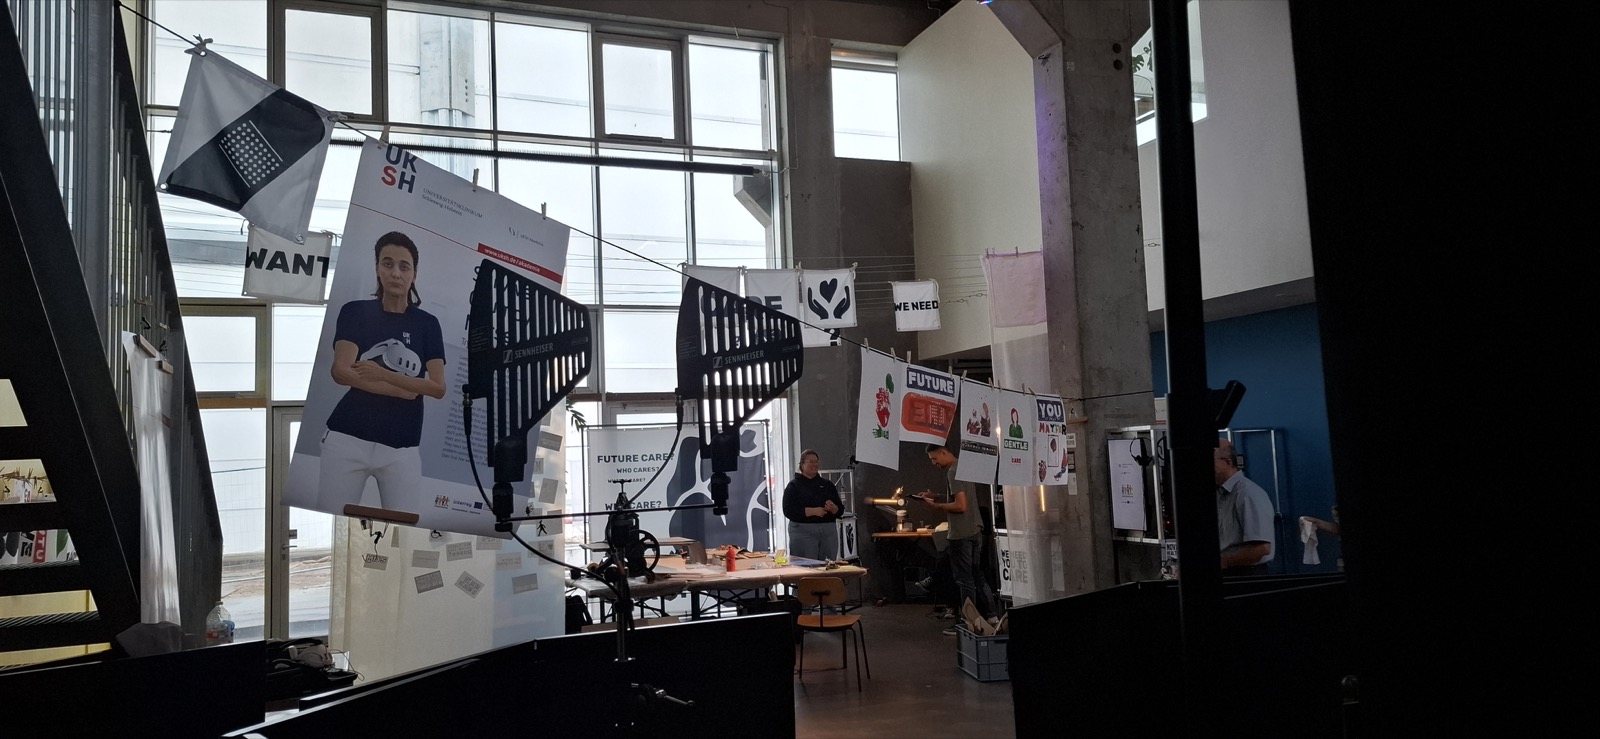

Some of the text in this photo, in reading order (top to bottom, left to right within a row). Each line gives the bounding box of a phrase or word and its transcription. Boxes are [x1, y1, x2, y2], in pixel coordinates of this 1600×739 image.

[385, 144, 418, 174] UK
[381, 165, 416, 194] SH
[245, 246, 330, 279] WANT
[894, 300, 939, 312] WE NEED
[514, 342, 554, 359] SENNHEISER
[724, 350, 765, 364] SENNHEISER
[908, 371, 954, 393] FUTURE
[1039, 403, 1062, 418] YOU
[1004, 440, 1028, 450] GENTLE
[597, 453, 675, 463] FUTURE CARE?
